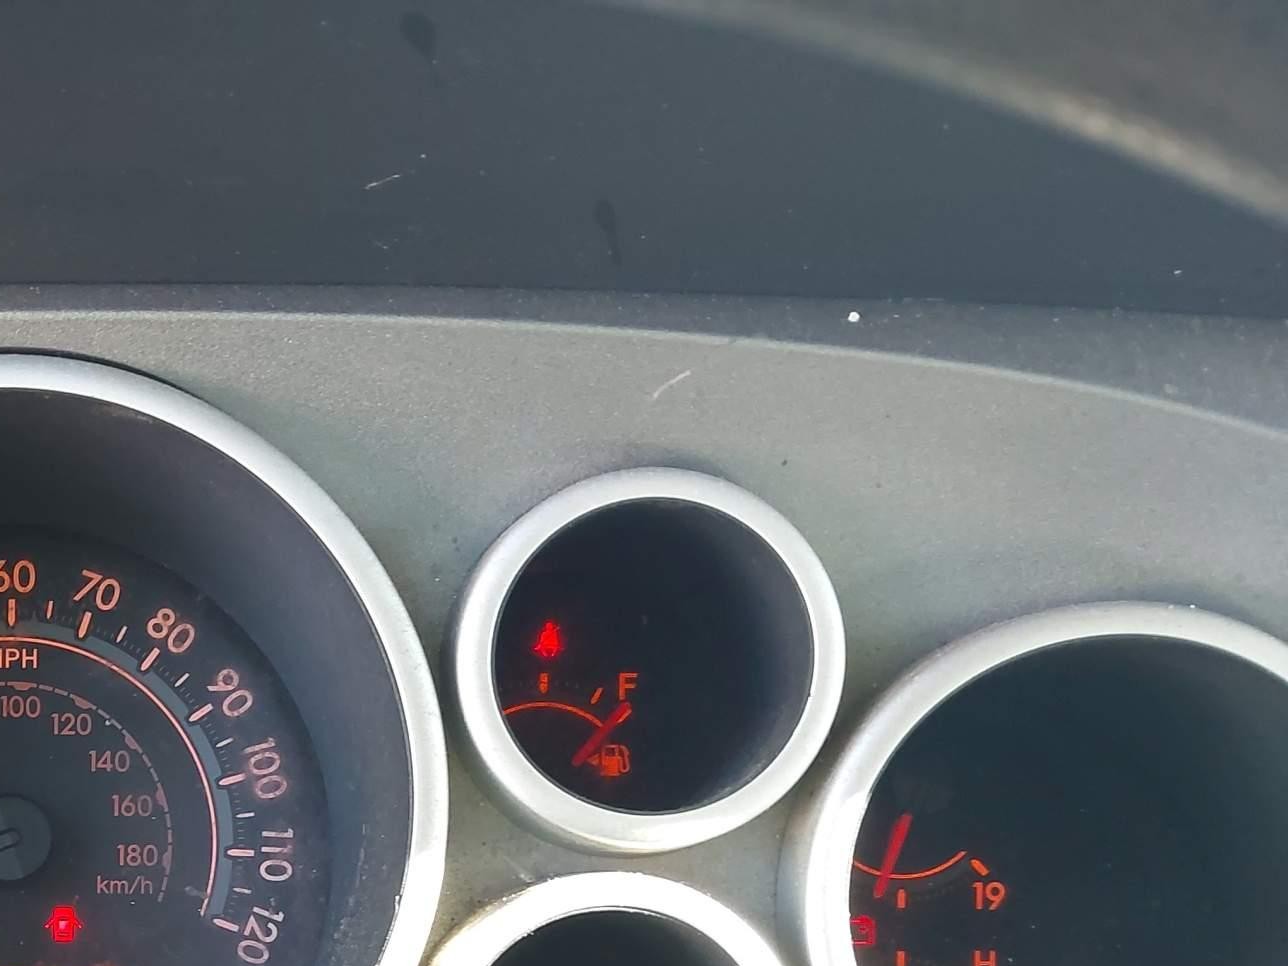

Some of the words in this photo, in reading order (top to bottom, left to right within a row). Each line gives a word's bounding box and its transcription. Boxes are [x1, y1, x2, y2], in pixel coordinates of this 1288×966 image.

[73, 569, 121, 612] 70
[146, 608, 194, 654] 80
[207, 668, 253, 717] 90
[619, 673, 638, 700] F
[0, 696, 41, 718] 100
[51, 714, 92, 736] 120
[89, 751, 130, 773] 140
[244, 737, 287, 799] 100
[112, 796, 152, 817] 160
[117, 845, 158, 866] 180
[261, 828, 294, 882] 110
[96, 875, 153, 897] km/h
[972, 881, 1006, 910] 19
[237, 902, 285, 965] 120
